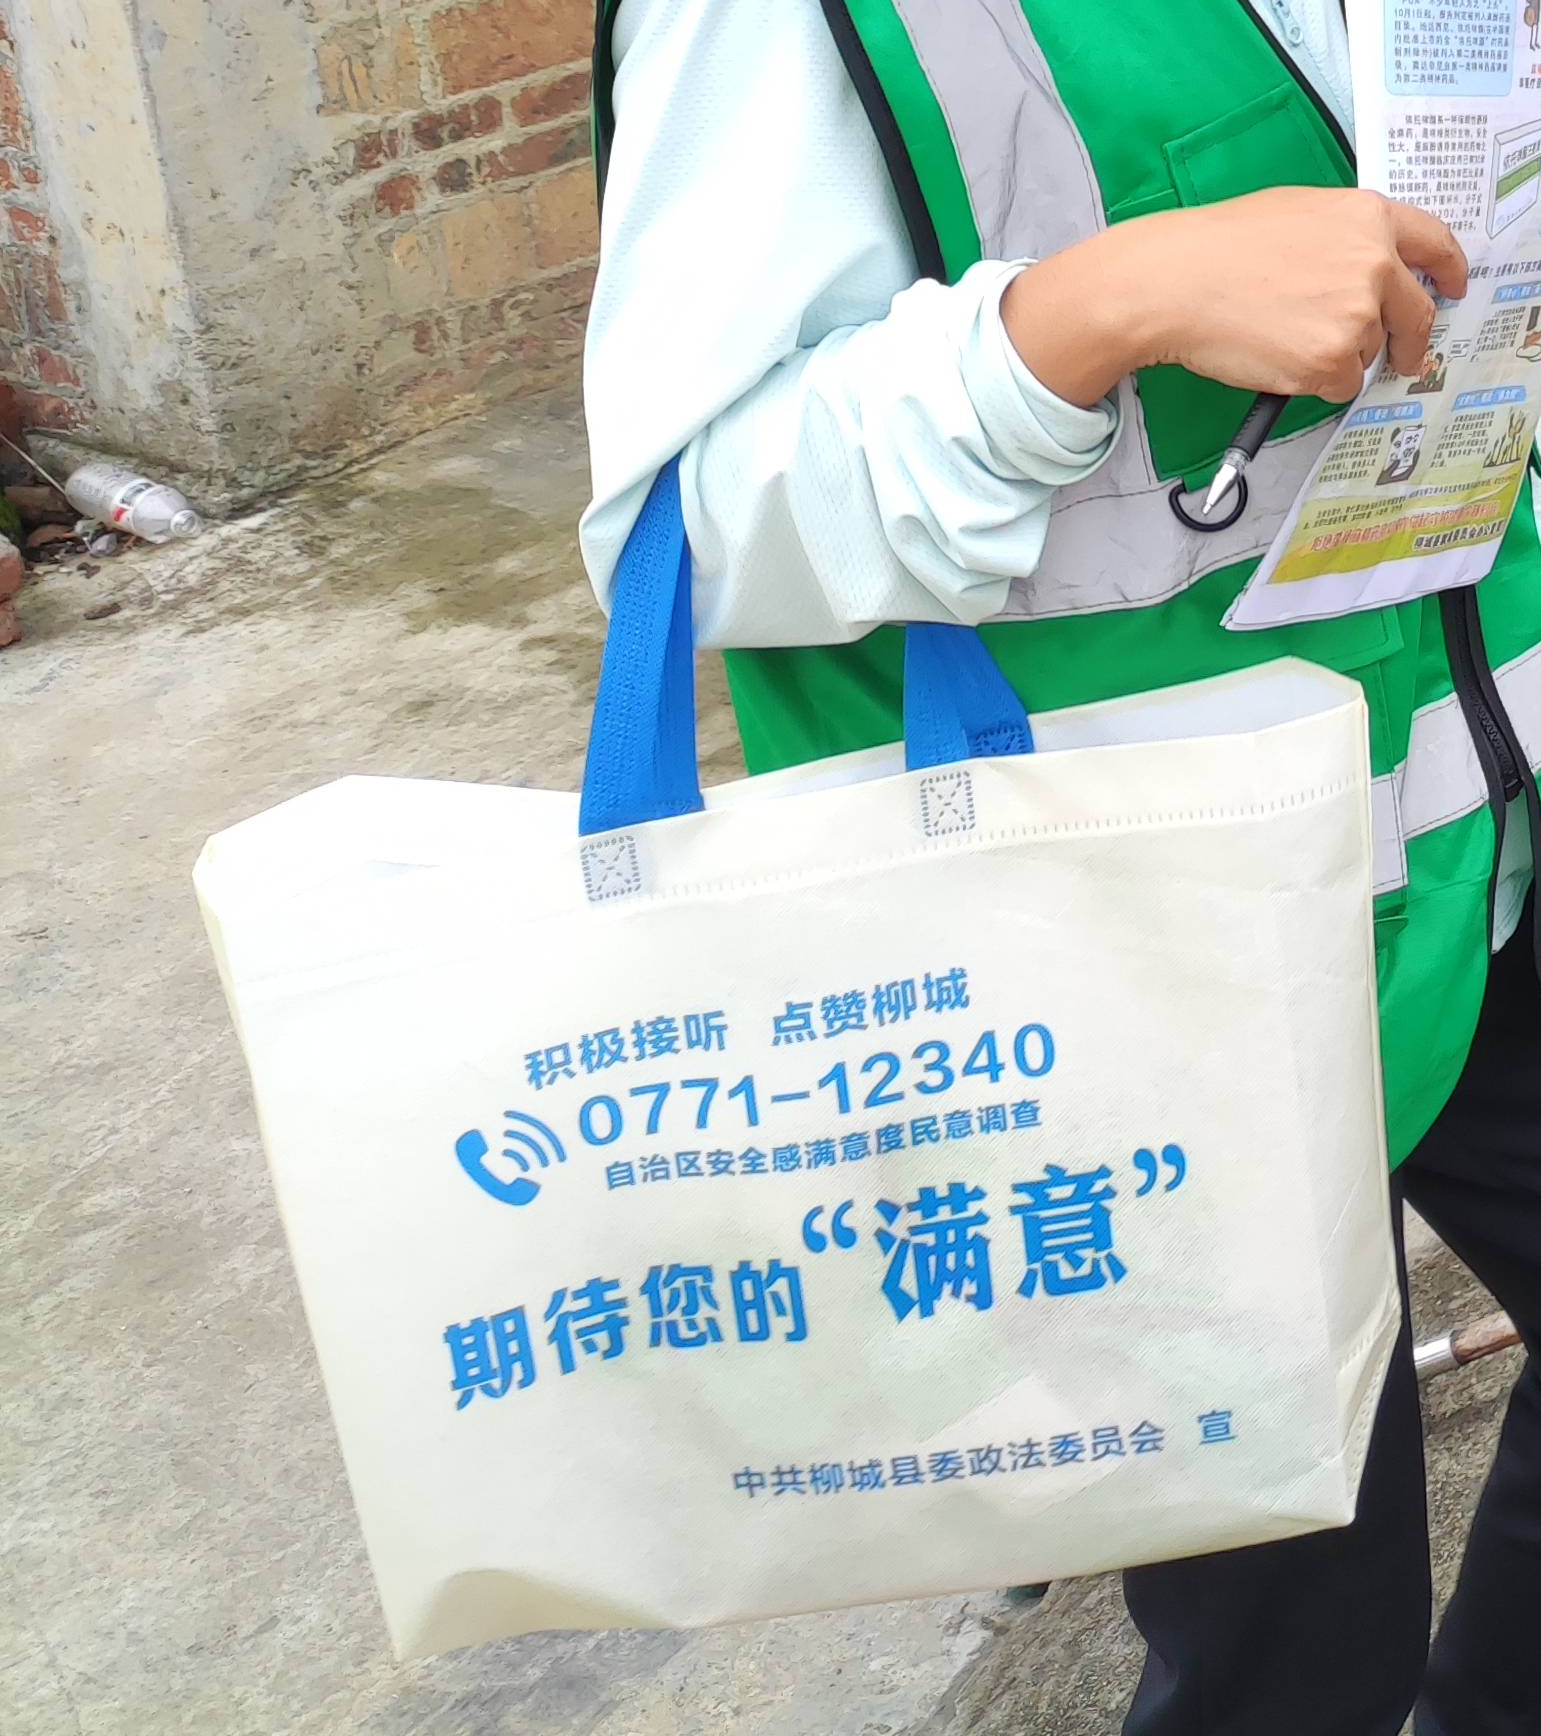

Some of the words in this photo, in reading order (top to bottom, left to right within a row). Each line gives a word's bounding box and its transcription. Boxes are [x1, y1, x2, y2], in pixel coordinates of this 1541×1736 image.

[526, 1011, 727, 1089] 积极接听
[772, 967, 970, 1047] 点赞柳城
[577, 1022, 1057, 1148] 0771-12340
[606, 1099, 1043, 1190] 自治区安全感满意度民意调查
[442, 1143, 1189, 1411] 期待您的“满意”
[731, 1419, 1167, 1501] 中共柳城县委政法委员会
[1199, 1410, 1236, 1445] 宣
